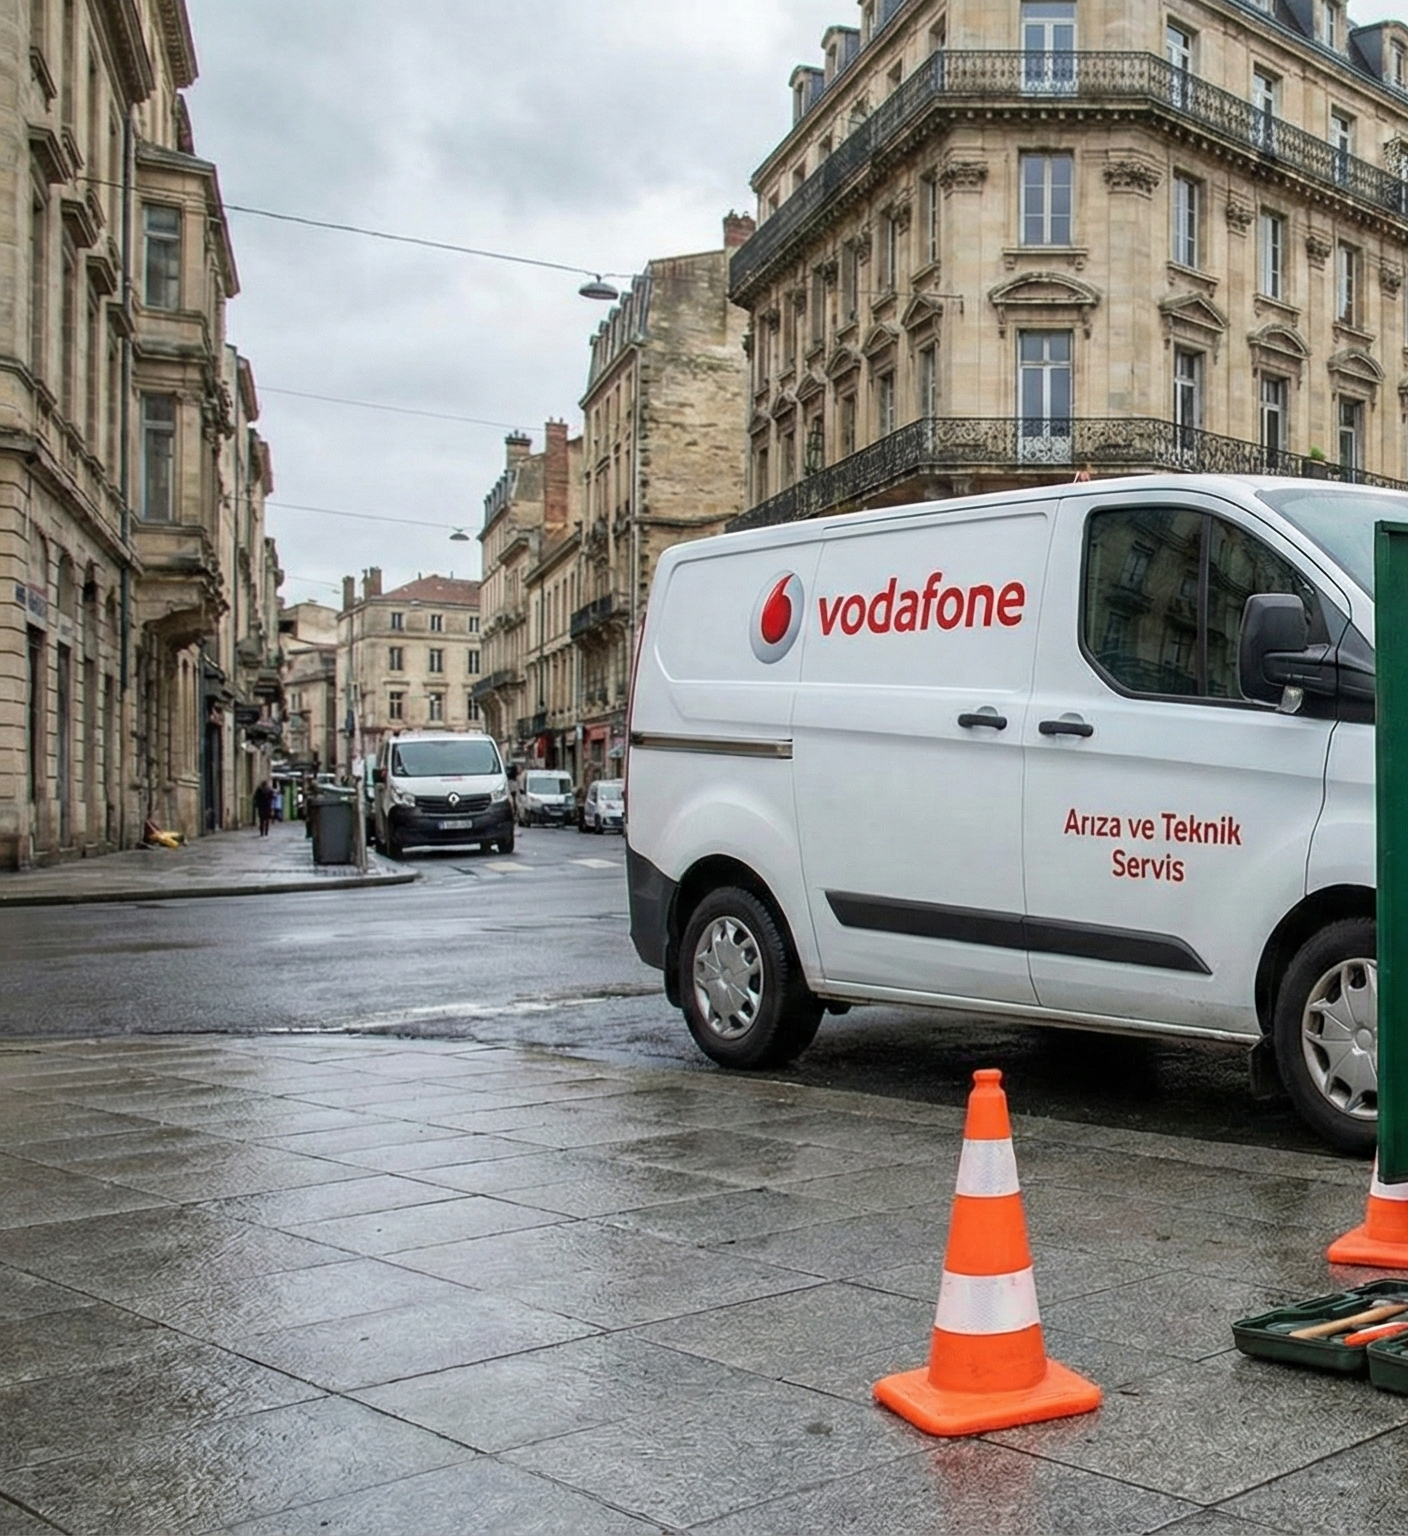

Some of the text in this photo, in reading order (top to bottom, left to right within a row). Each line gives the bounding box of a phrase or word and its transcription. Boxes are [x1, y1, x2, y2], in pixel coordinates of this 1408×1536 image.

[819, 572, 1025, 635] vodafone
[1064, 808, 1241, 845] Arıza ve Teknik
[1112, 849, 1184, 882] Servis
